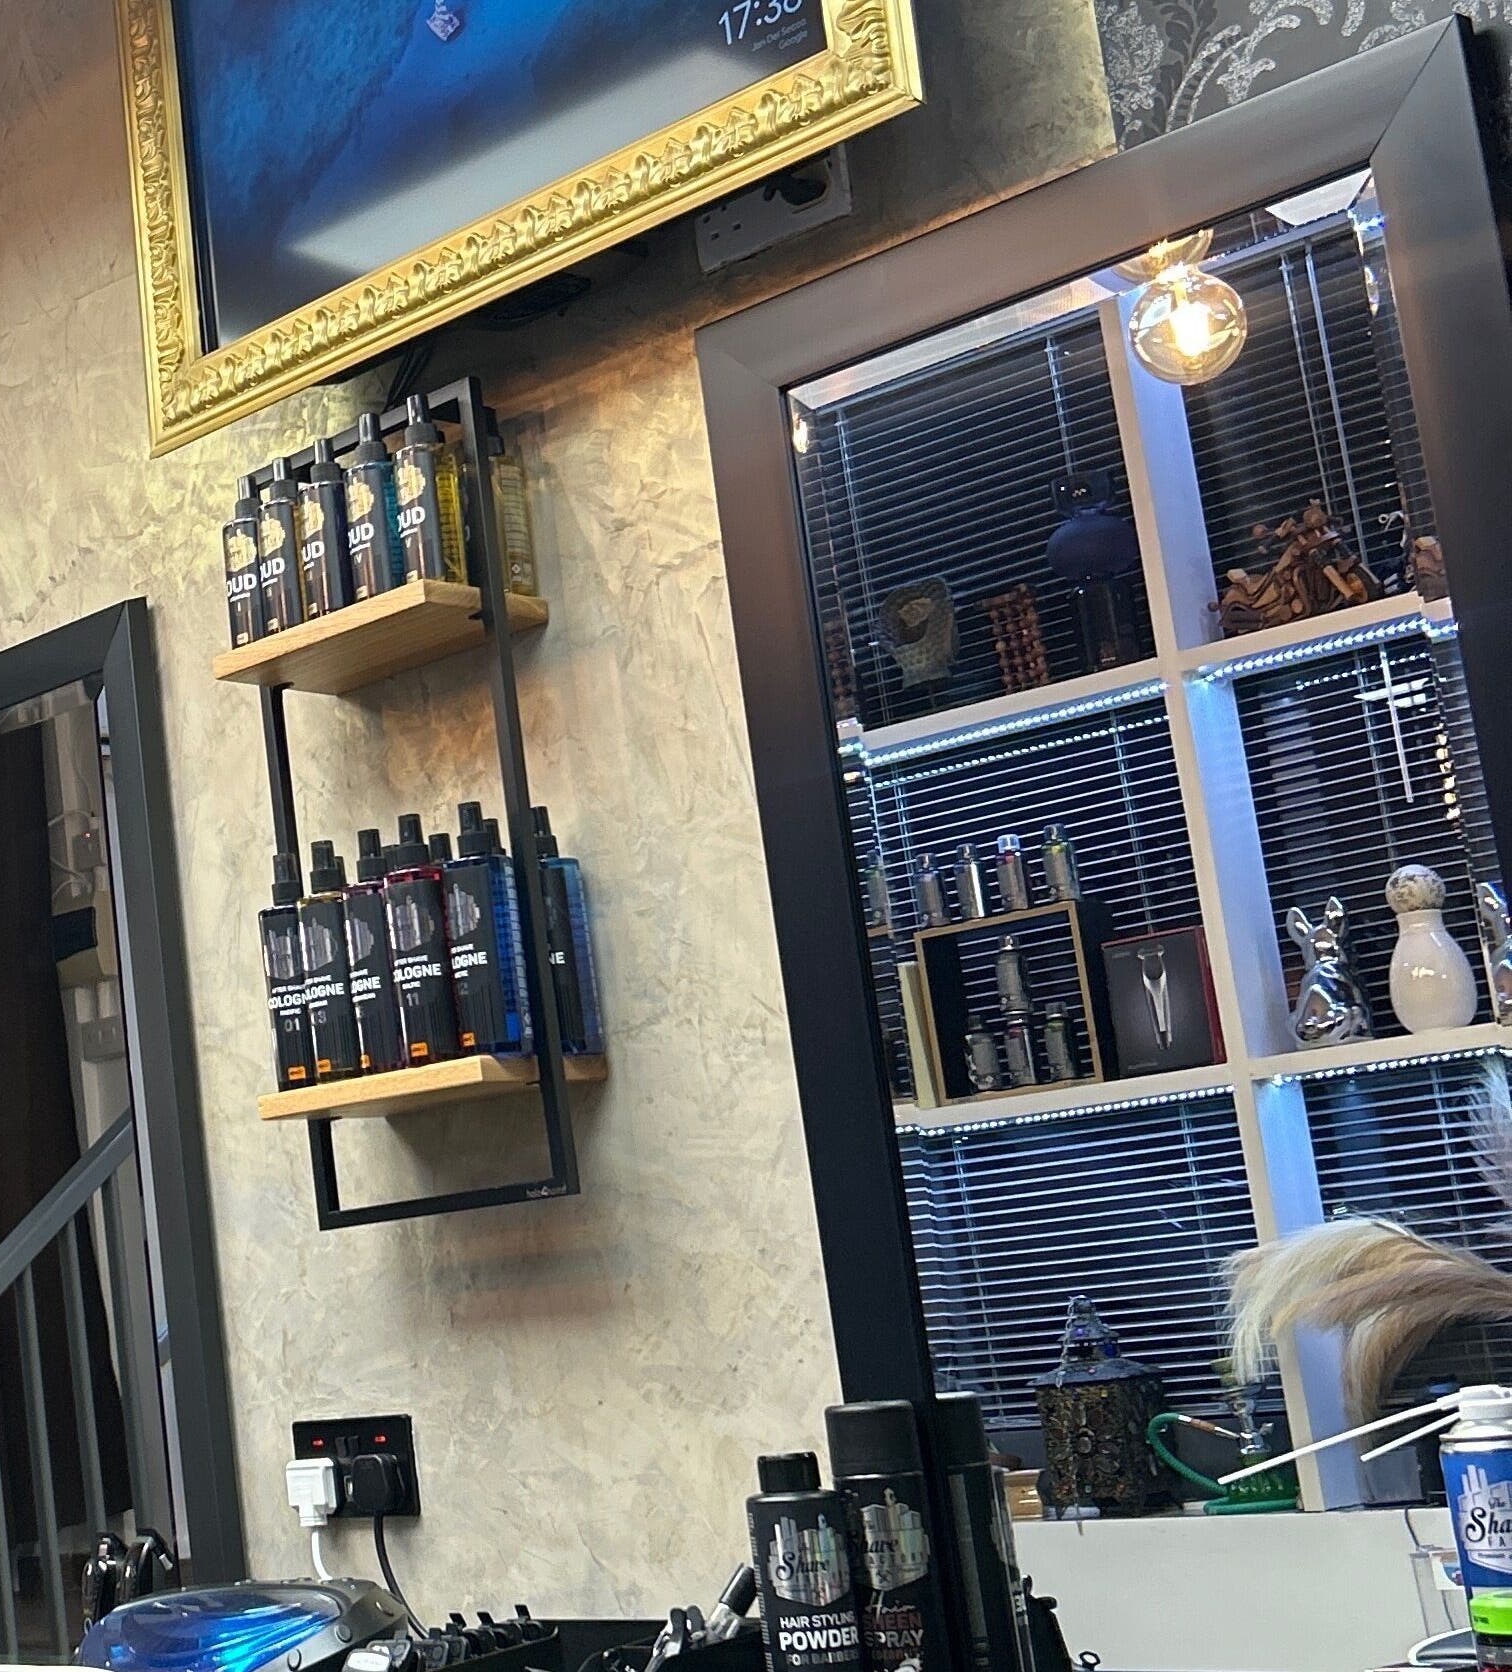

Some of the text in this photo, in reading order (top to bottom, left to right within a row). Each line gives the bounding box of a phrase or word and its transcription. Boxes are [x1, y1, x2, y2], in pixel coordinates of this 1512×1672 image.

[302, 541, 325, 562] UD
[451, 951, 487, 970] LOGNE
[305, 982, 345, 1001] LOGNE
[351, 976, 382, 995] OGNE
[779, 1616, 810, 1629] HAIR
[778, 1626, 860, 1651] POWDER
[863, 1629, 924, 1648] SPRAY
